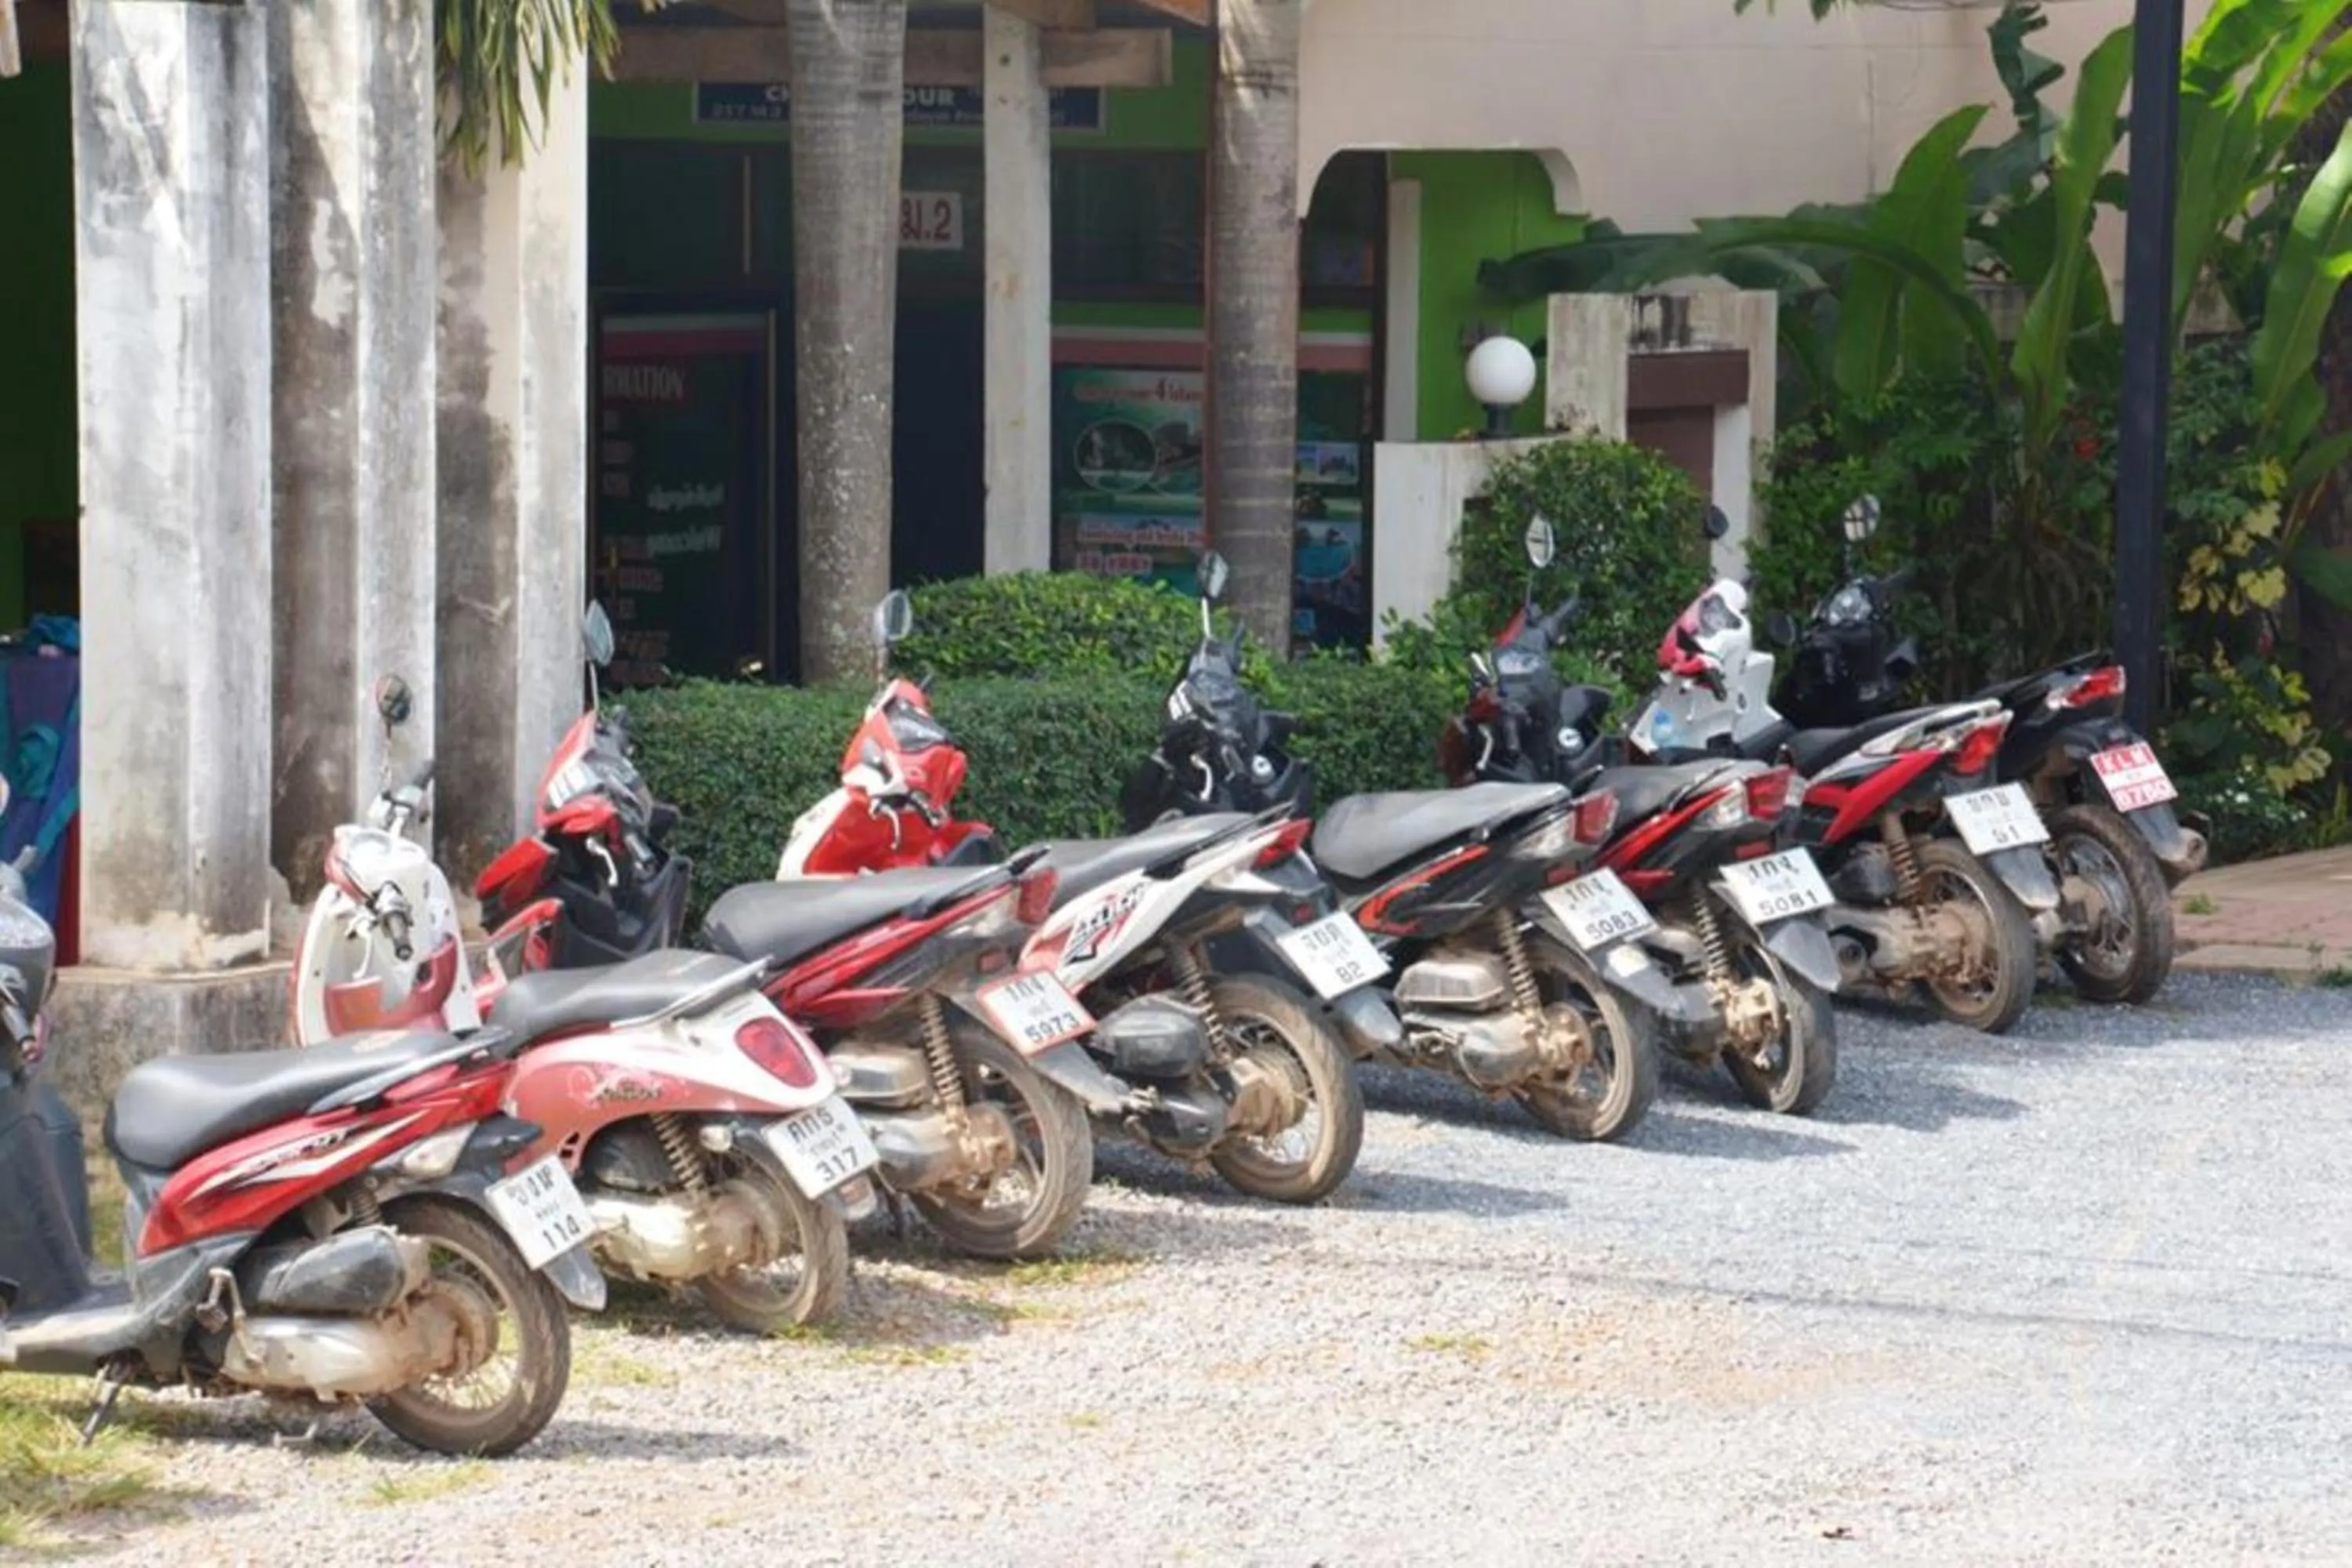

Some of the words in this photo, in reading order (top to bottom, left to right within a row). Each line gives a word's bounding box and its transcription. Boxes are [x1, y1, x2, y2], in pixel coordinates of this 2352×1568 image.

[1759, 888, 1818, 916] 5081
[1585, 909, 1638, 940] 5083
[1024, 1011, 1080, 1043] 5973
[815, 1146, 858, 1181] 317
[543, 1214, 580, 1250] 114
